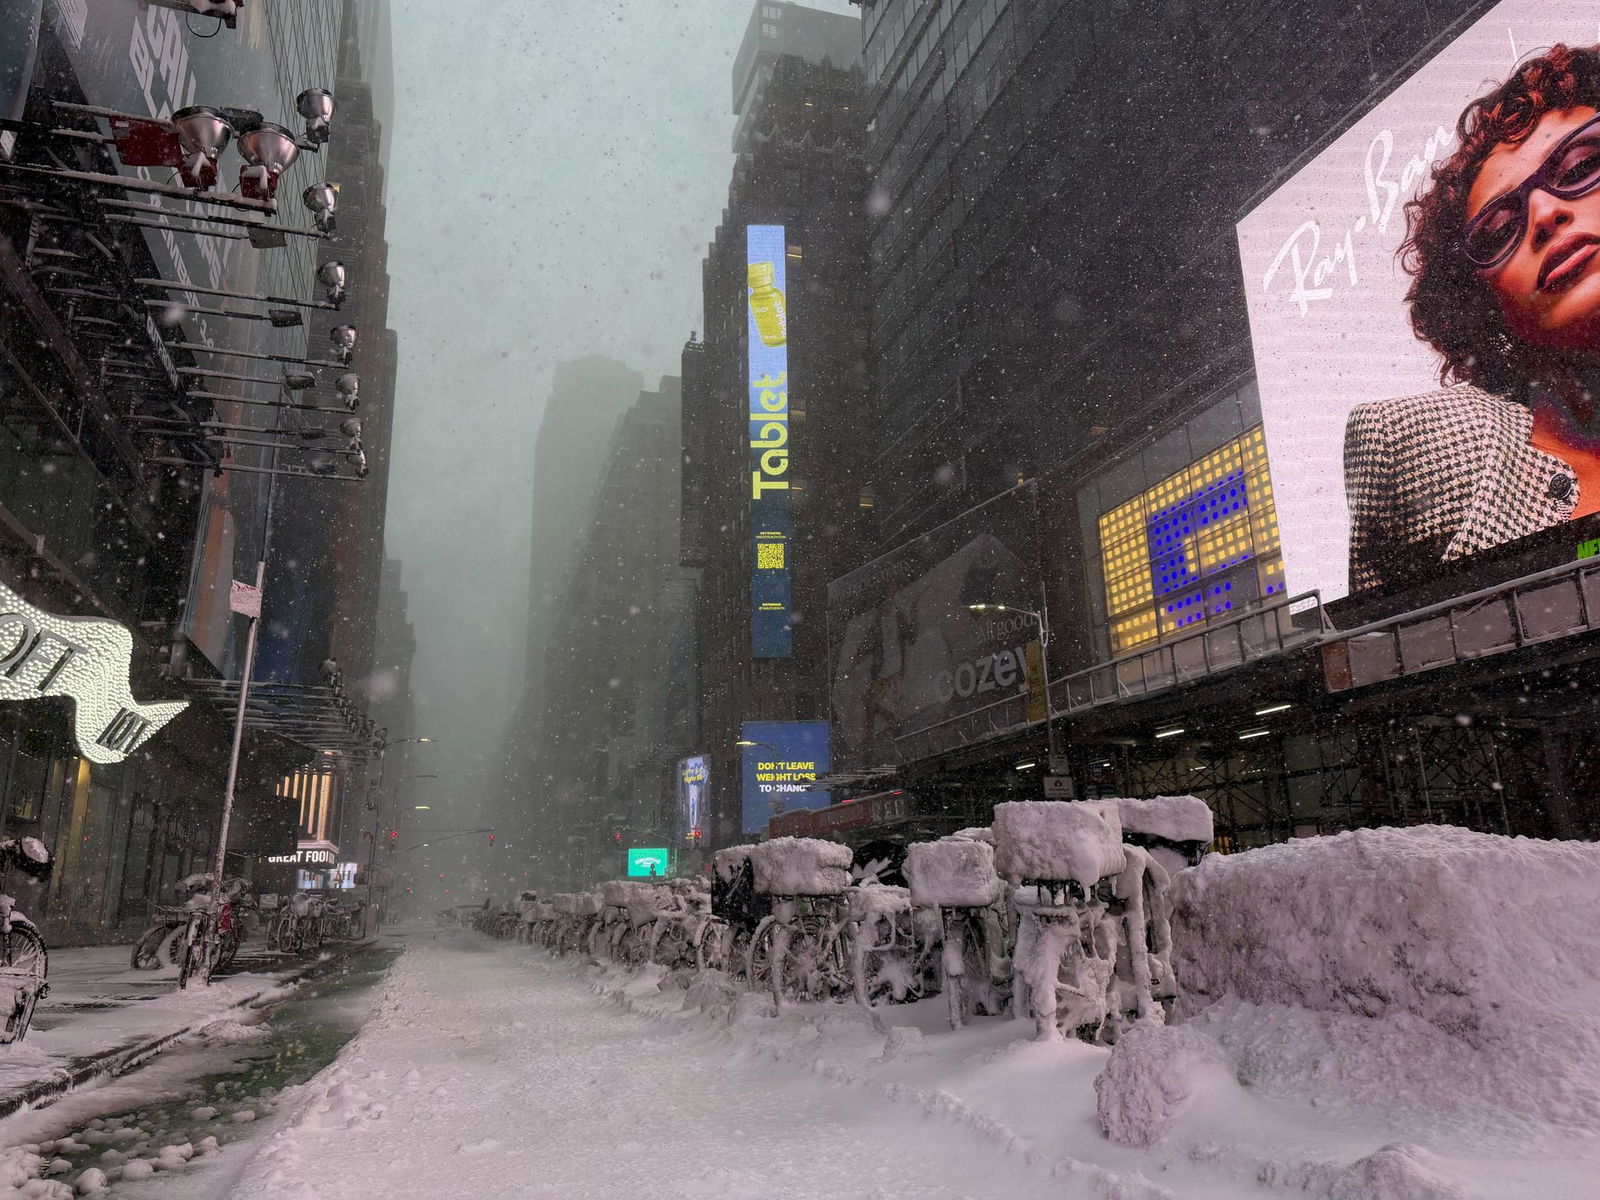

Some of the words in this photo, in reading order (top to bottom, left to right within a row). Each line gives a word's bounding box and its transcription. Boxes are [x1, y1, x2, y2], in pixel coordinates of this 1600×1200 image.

[750, 370, 789, 500] Tablet
[758, 762, 786, 771] DON'T
[786, 762, 815, 770] LEAVE
[756, 773, 792, 782] WEIGHT
[793, 773, 817, 781] LOSS
[759, 784, 772, 793] TO
[268, 850, 303, 863] GREAT
